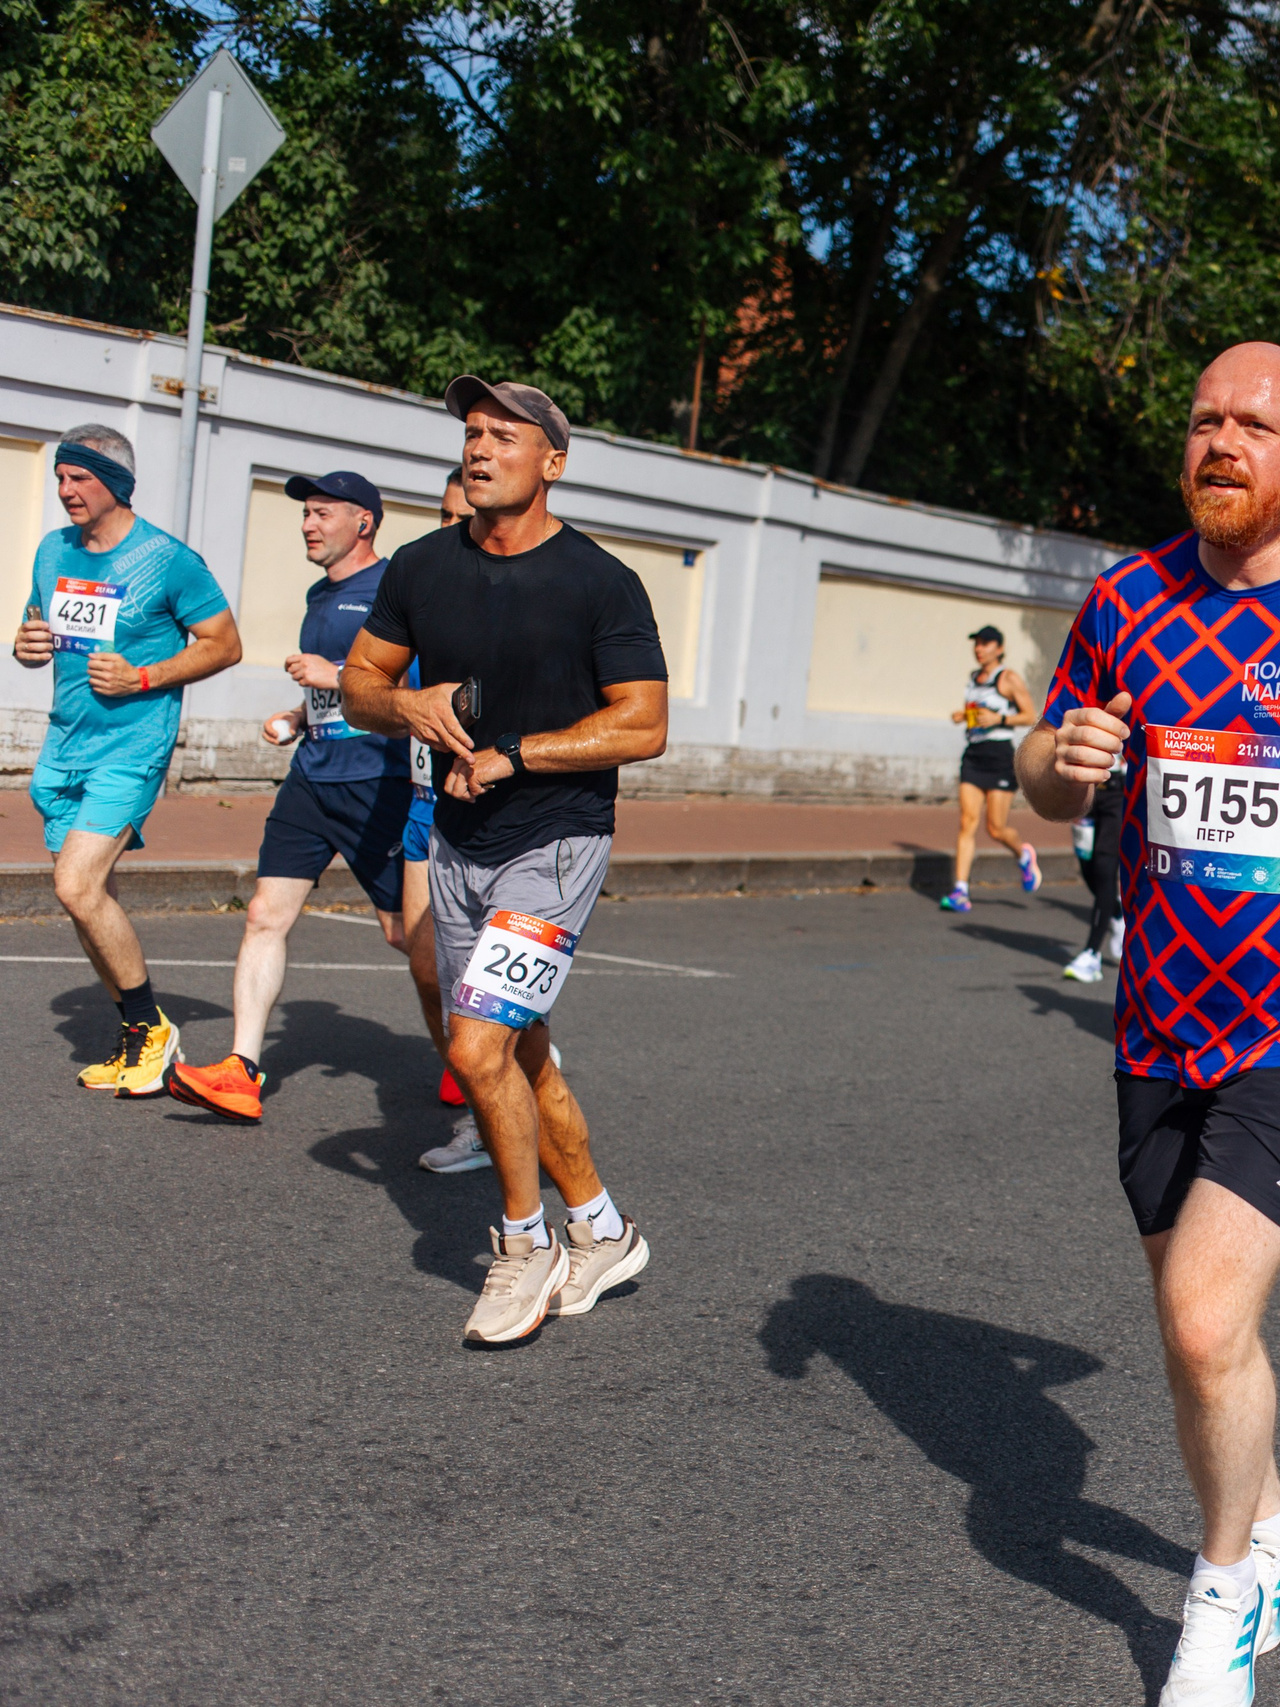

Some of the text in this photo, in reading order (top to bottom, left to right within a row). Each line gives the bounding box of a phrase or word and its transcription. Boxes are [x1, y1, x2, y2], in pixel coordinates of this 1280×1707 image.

[112, 534, 170, 575] MIZUNO
[57, 600, 107, 626] 4231
[65, 624, 96, 634] ВАСИЛИЙ
[1165, 730, 1192, 741] ПОЛУ
[1164, 740, 1215, 753] МАРАФОН
[1237, 743, 1259, 759] 21,1
[1162, 772, 1280, 828] 5155
[1197, 827, 1235, 843] ПЕТР
[1157, 848, 1171, 875] D
[507, 918, 543, 935] МАРАФОН
[483, 943, 559, 994] 2673
[501, 983, 535, 1001] АЛЕКСЕЙ
